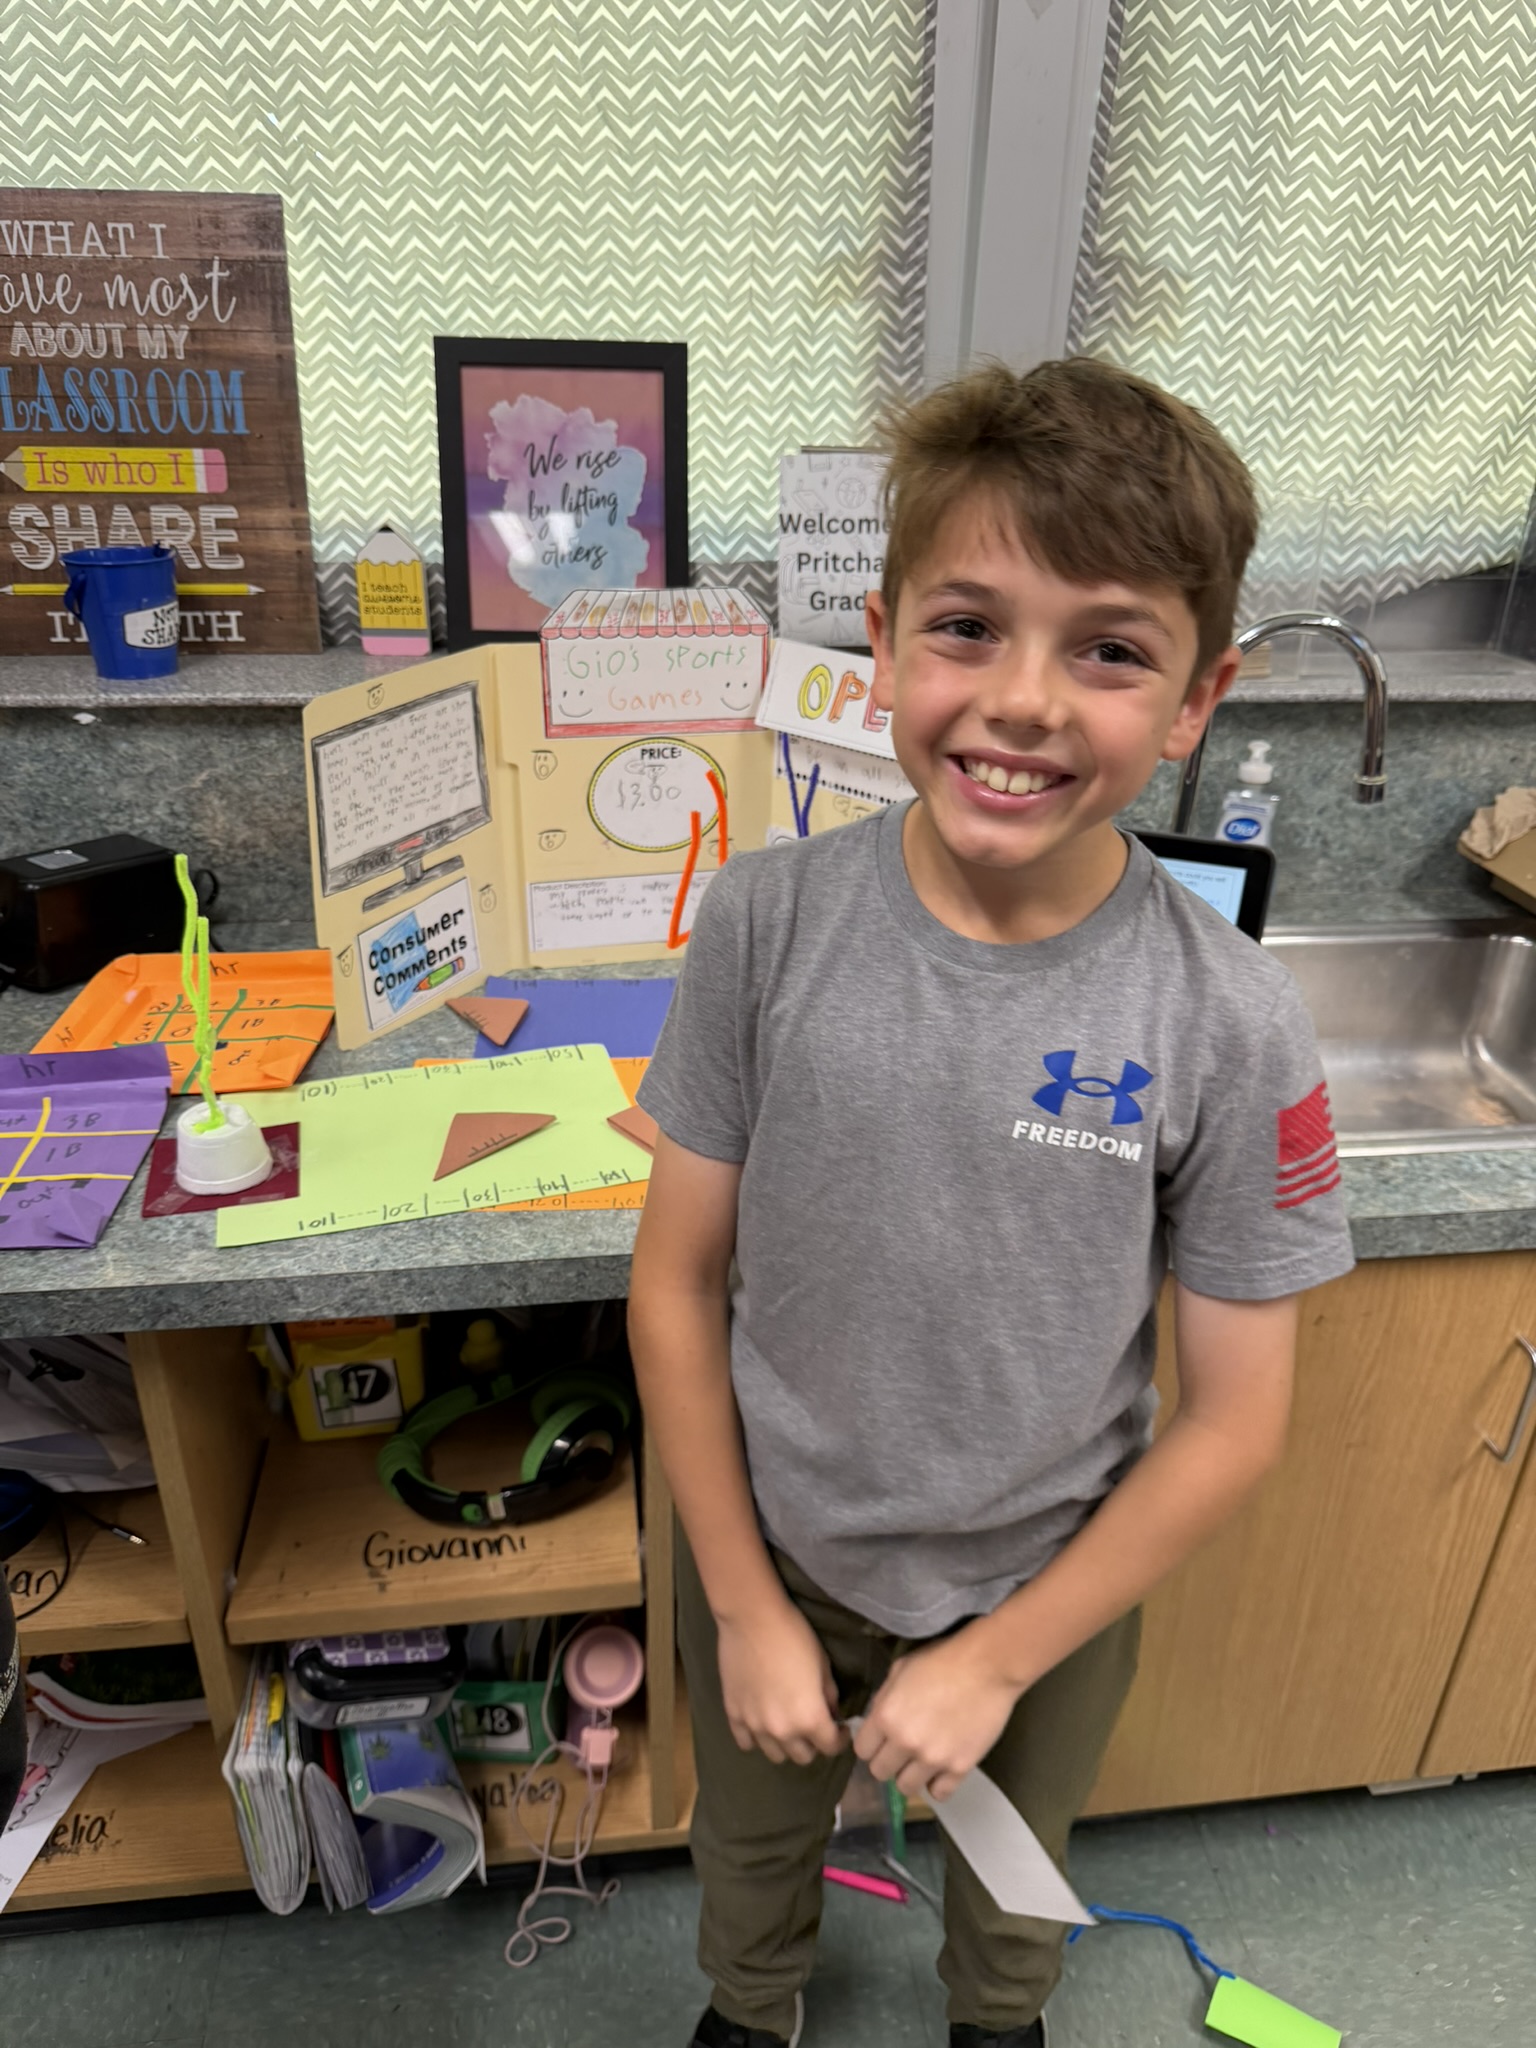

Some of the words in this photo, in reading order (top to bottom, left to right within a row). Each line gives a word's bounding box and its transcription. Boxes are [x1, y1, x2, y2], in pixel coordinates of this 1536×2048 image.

[0, 219, 135, 258] WHAT
[149, 223, 170, 259] I
[0, 272, 82, 314] ove
[103, 256, 236, 323] most
[10, 321, 127, 359] ABOUT
[136, 323, 190, 360] MY
[0, 363, 250, 434] LASSROOM
[33, 452, 69, 486] Is
[80, 453, 157, 486] who
[168, 453, 186, 487] I
[524, 434, 567, 478] We
[575, 449, 621, 479] rise
[528, 490, 551, 541] by
[560, 483, 619, 528] lifting
[8, 503, 245, 570] SHARE
[797, 551, 884, 573] Pritcha
[809, 590, 868, 612] Grad
[641, 747, 682, 760] PRICE:
[1227, 822, 1260, 837] Dial
[18, 1057, 57, 1079] hr
[1011, 1119, 1143, 1163] FREEDOM
[347, 1368, 378, 1400] 17
[362, 1530, 528, 1571] Giovanni
[480, 1704, 512, 1734] 18
[50, 1812, 113, 1847] elia
